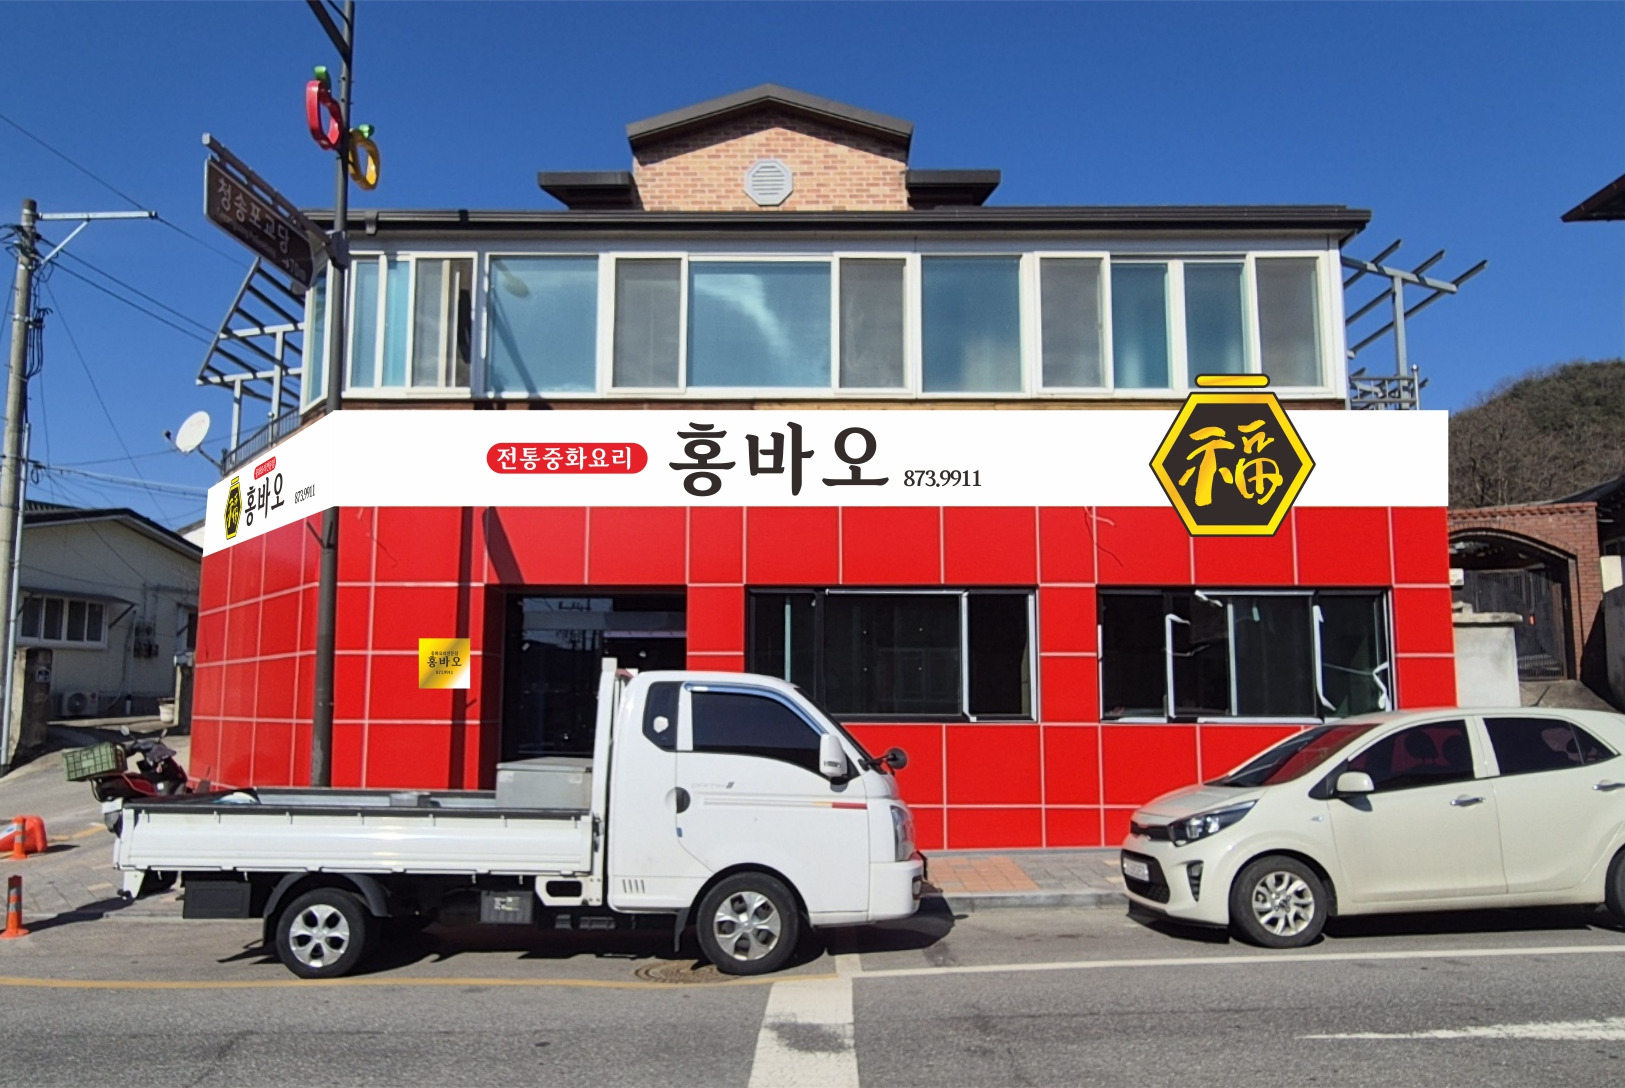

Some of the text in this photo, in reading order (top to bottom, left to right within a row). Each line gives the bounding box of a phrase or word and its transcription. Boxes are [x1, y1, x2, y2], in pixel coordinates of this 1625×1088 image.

[217, 177, 290, 255] 청송포교당
[496, 446, 632, 471] 전통중화요리
[669, 421, 890, 497] 홍바오
[903, 469, 982, 488] 873.9911
[1178, 419, 1284, 507] 福
[244, 472, 285, 527] 홍바오
[426, 655, 462, 668] 홍바오
